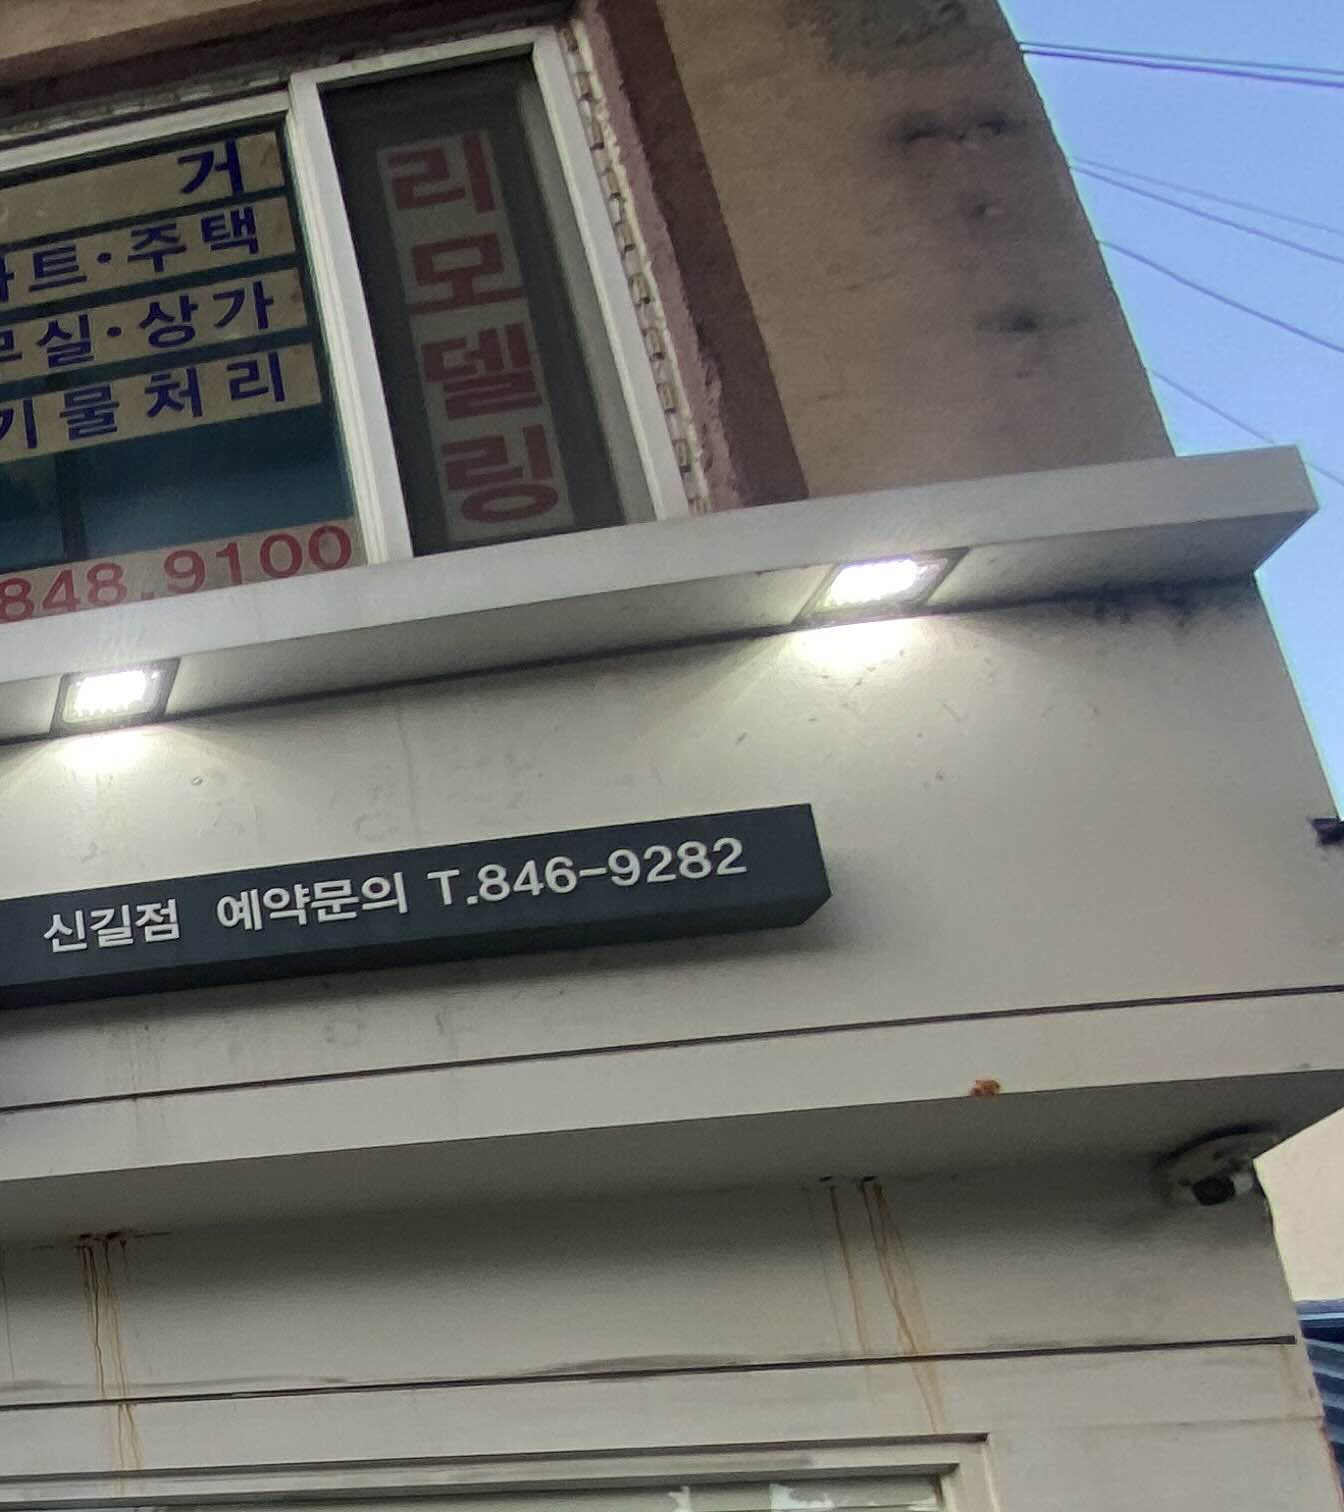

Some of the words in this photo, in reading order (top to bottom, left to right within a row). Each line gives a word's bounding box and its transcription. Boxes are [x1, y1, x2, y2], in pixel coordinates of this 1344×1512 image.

[386, 146, 559, 523] 리모델링
[43, 898, 180, 953] 신길점
[216, 871, 409, 933] 예약문의
[426, 837, 748, 907] T.846-9282
